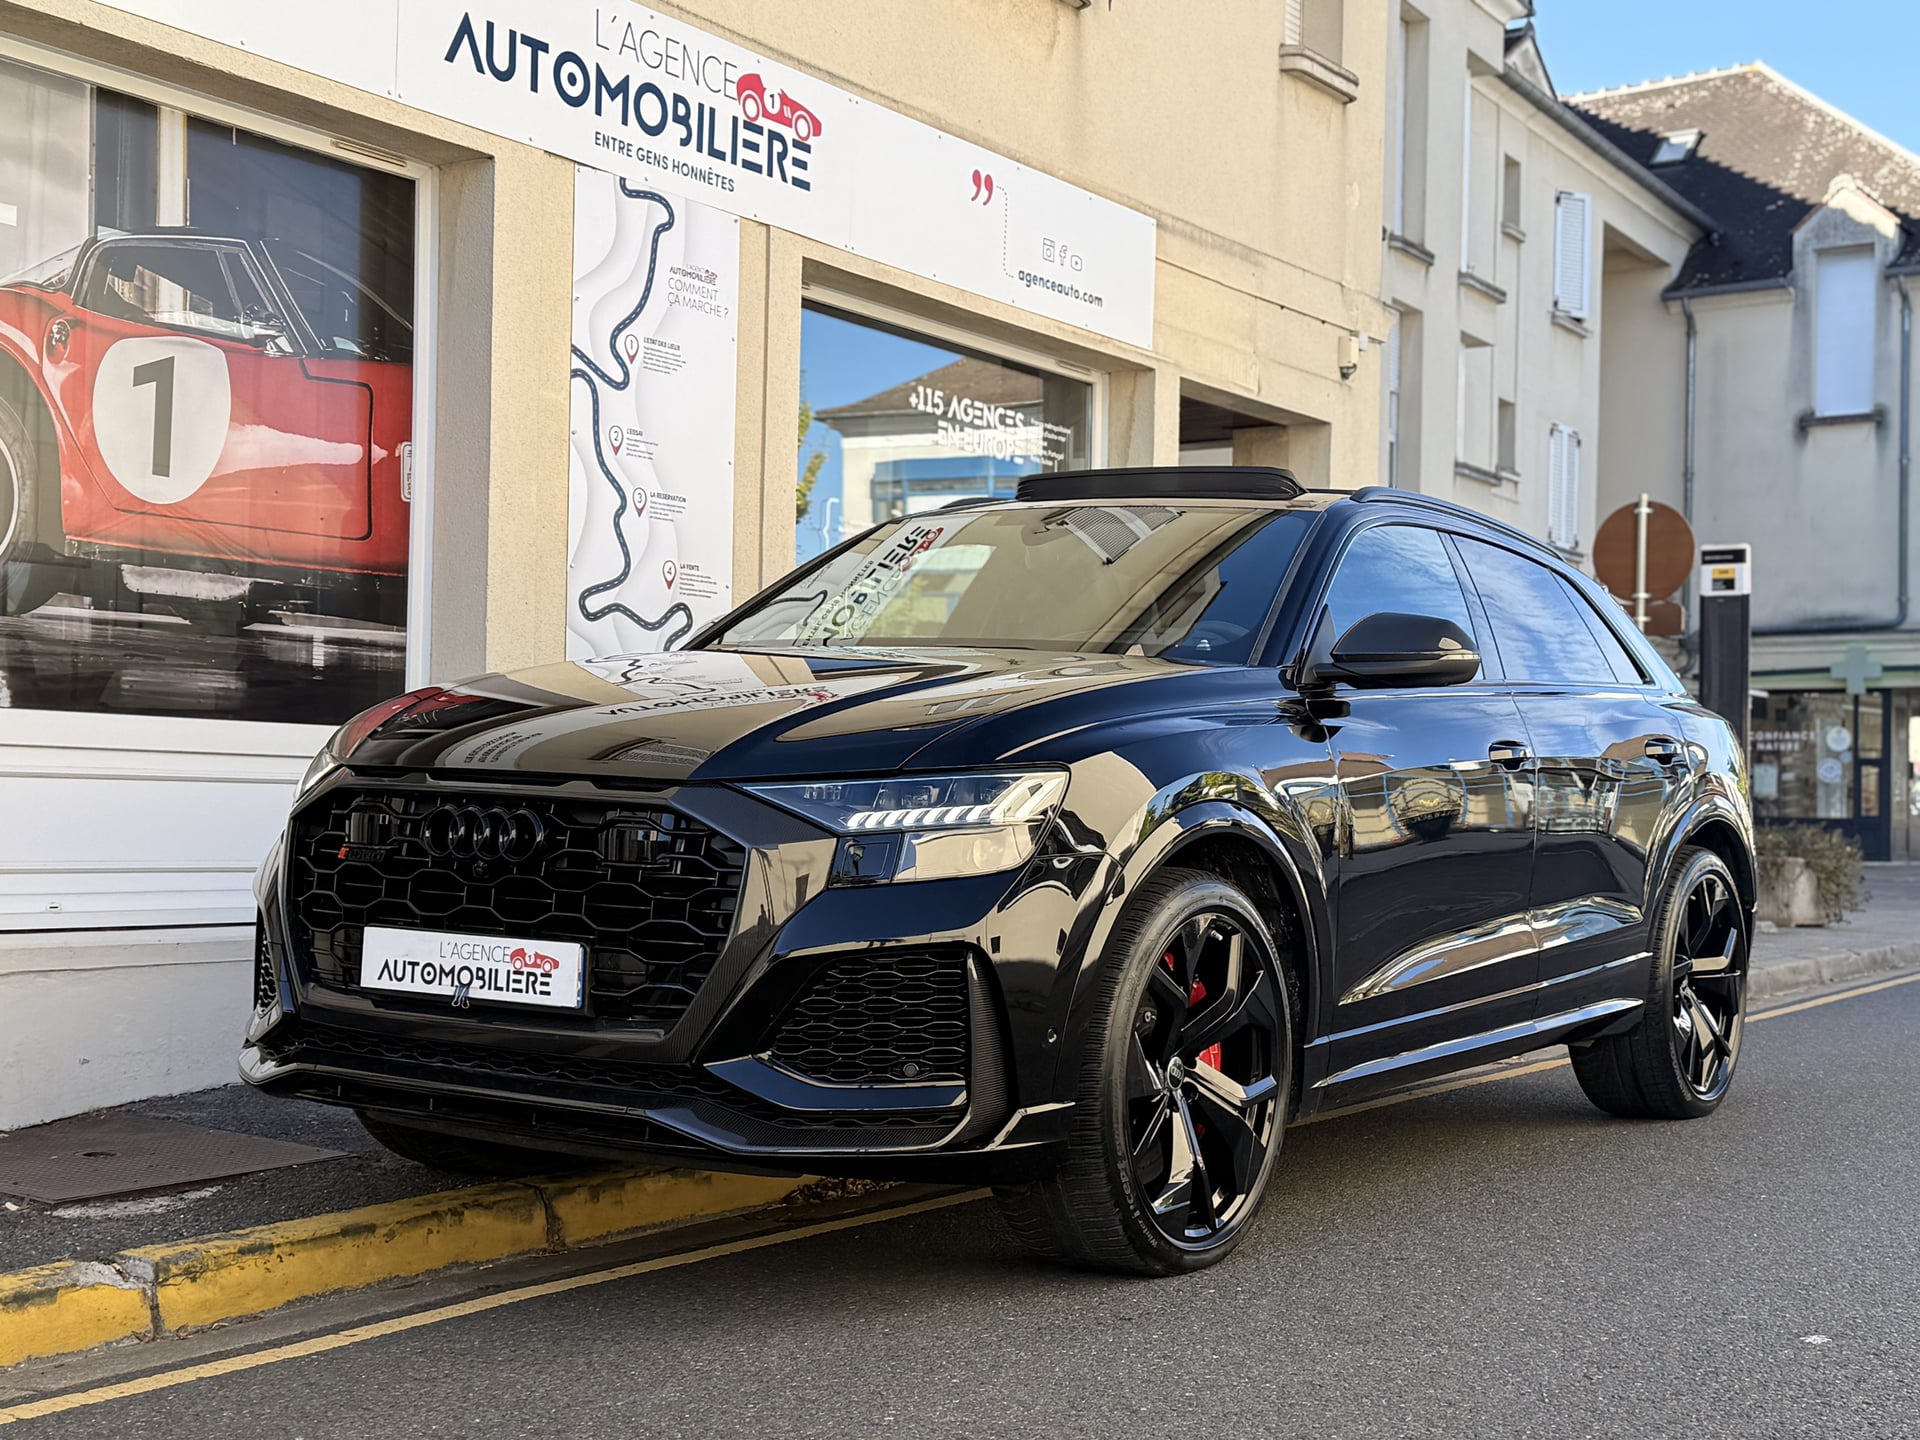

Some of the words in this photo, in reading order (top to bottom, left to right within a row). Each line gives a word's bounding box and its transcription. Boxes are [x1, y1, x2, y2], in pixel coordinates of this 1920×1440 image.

[596, 8, 738, 101] L'AGENCE
[444, 12, 812, 192] AUTOMOBILIERE
[594, 131, 633, 158] ENTRE
[636, 145, 669, 170] GENS
[672, 156, 735, 193] HONNÊTES
[668, 277, 719, 302] COMMENT
[668, 291, 681, 307] ÇA
[682, 295, 722, 318] MARCHE
[1018, 268, 1103, 308] agenceauto.com
[132, 356, 175, 478] 1
[909, 385, 944, 415] +115
[947, 395, 1025, 431] AGENCES
[613, 430, 619, 441] 2
[637, 492, 643, 503] 3
[439, 940, 511, 963] L'AGENCE
[377, 959, 553, 996] AUTOMOBILIERE
